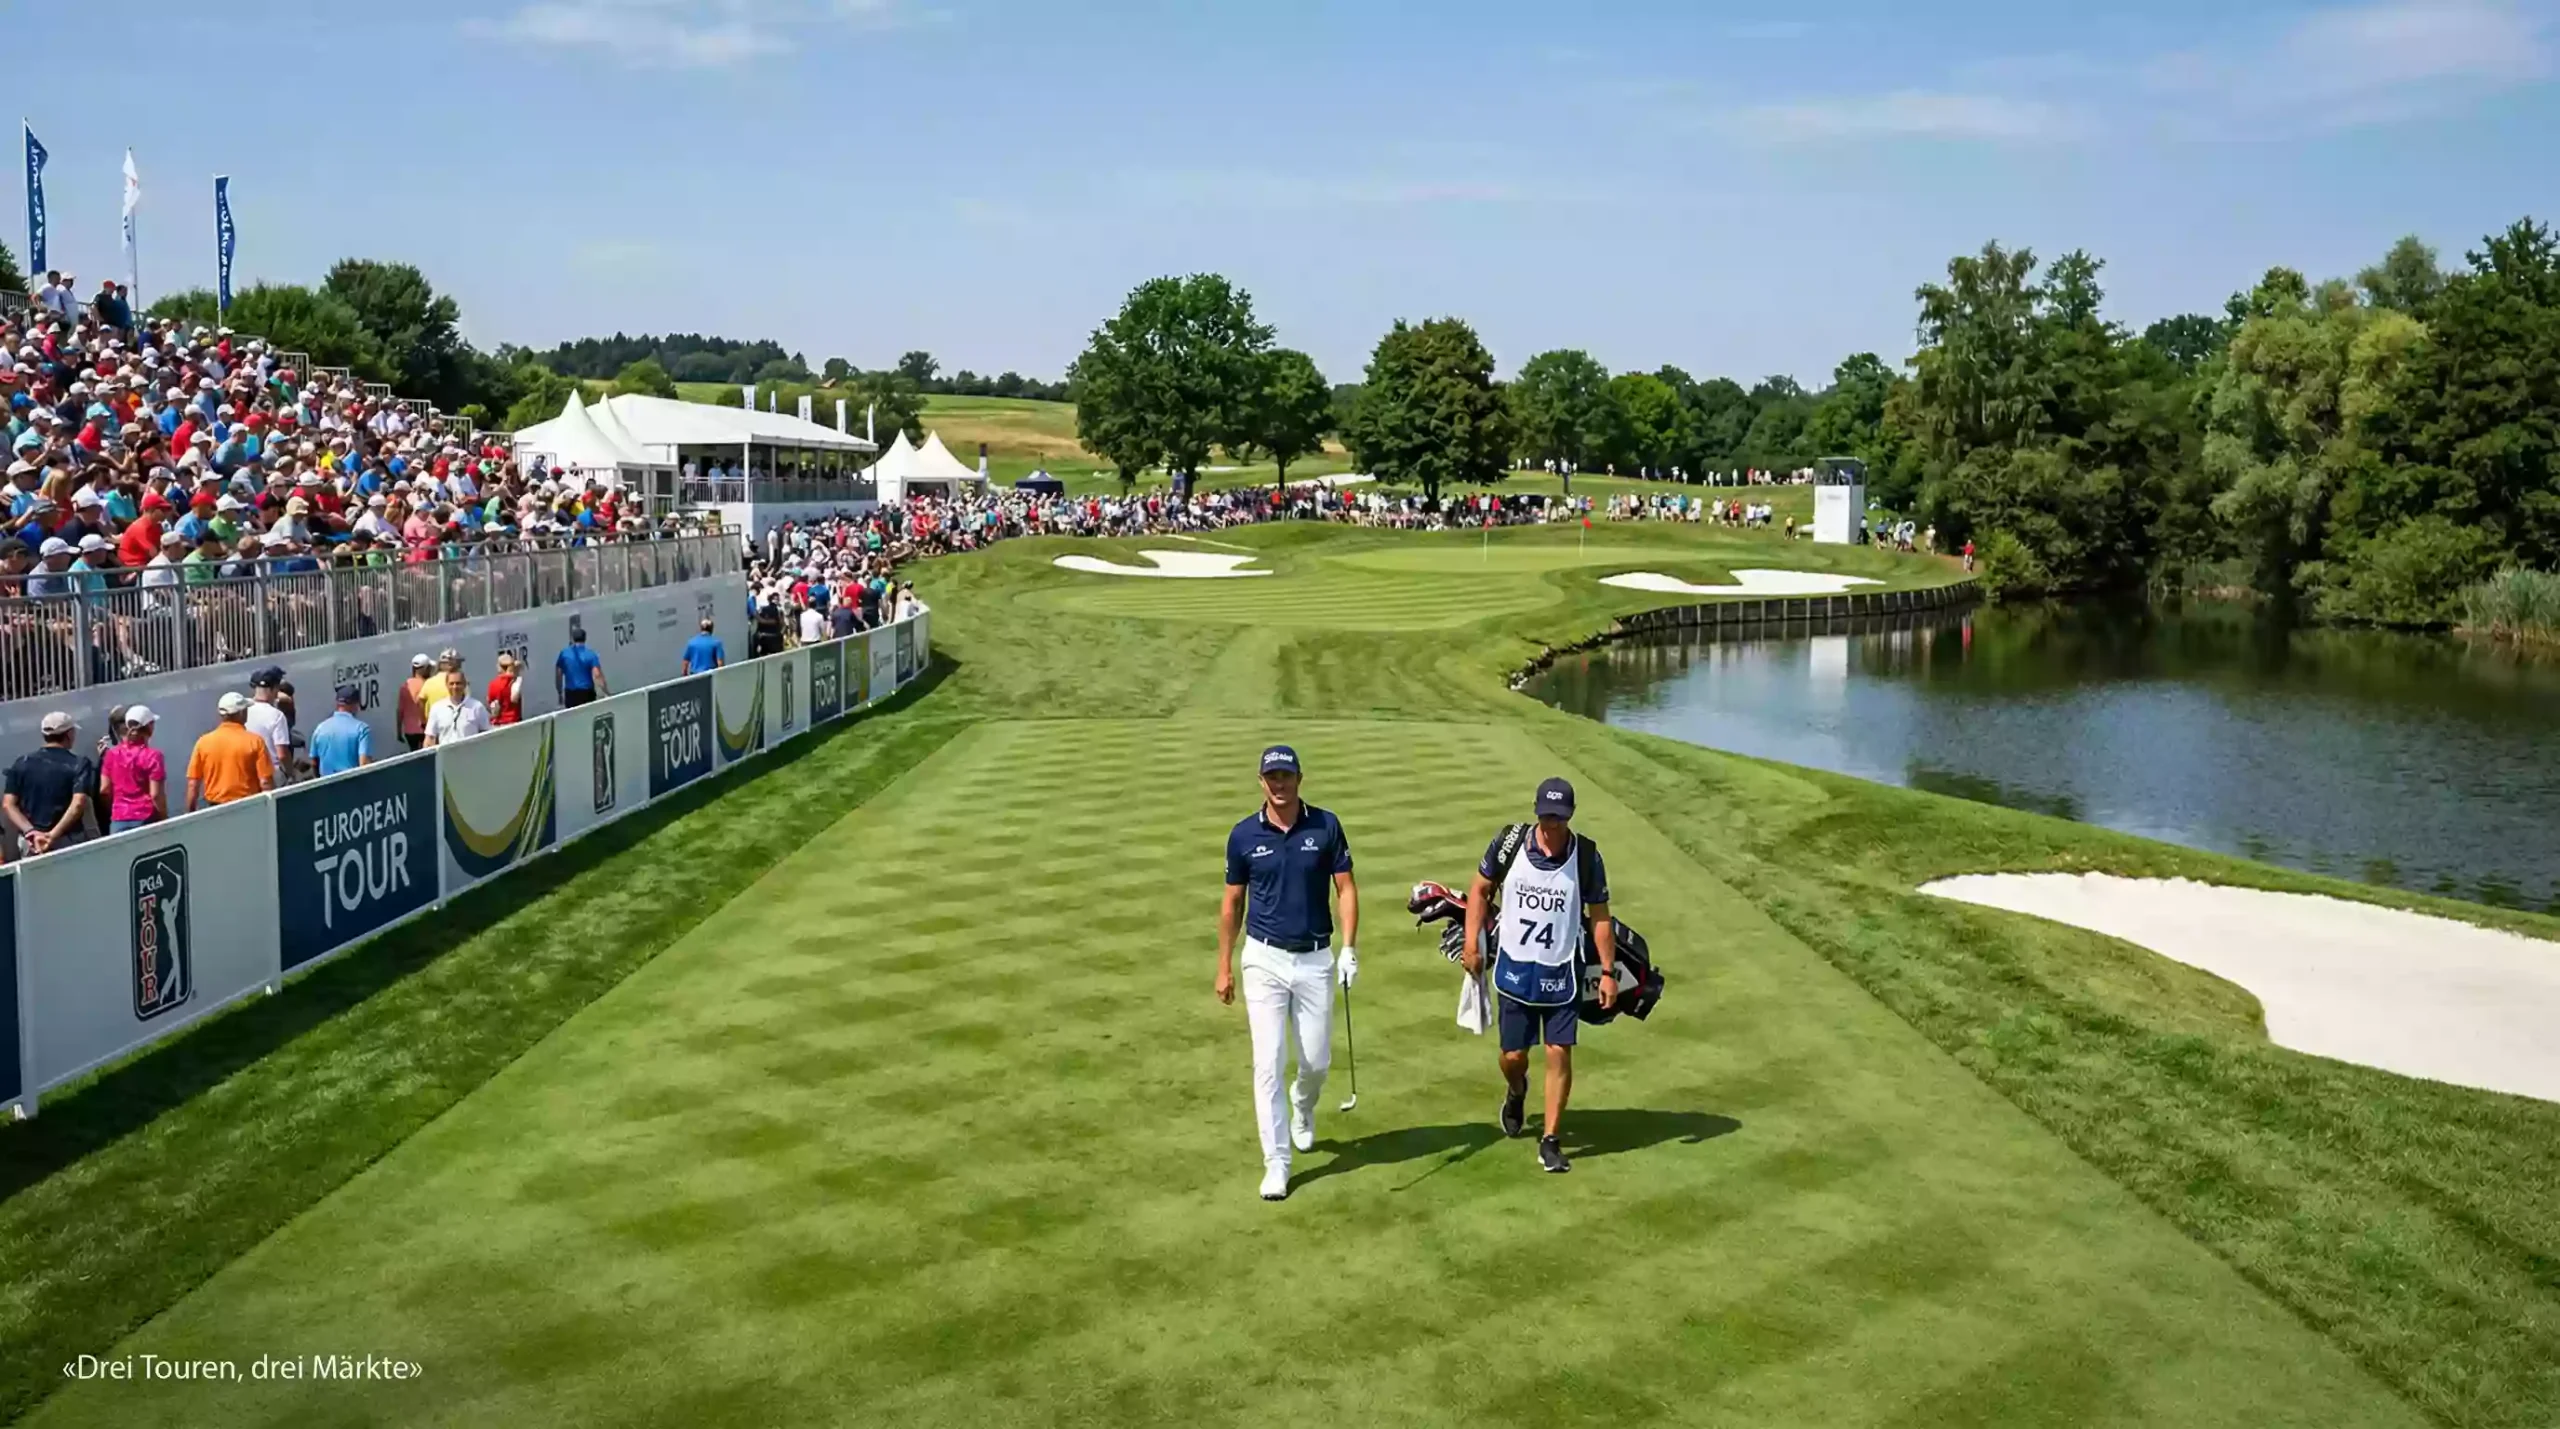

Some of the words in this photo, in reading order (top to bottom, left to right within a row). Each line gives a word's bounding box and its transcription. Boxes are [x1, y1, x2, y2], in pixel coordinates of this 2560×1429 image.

[660, 722, 702, 780] TOUR
[313, 792, 408, 853] EUROPEAN
[138, 874, 164, 895] PGA
[313, 831, 411, 930] TOUR
[1516, 890, 1566, 913] TOUR
[138, 893, 159, 1006] TOUR
[1519, 917, 1555, 950] 74
